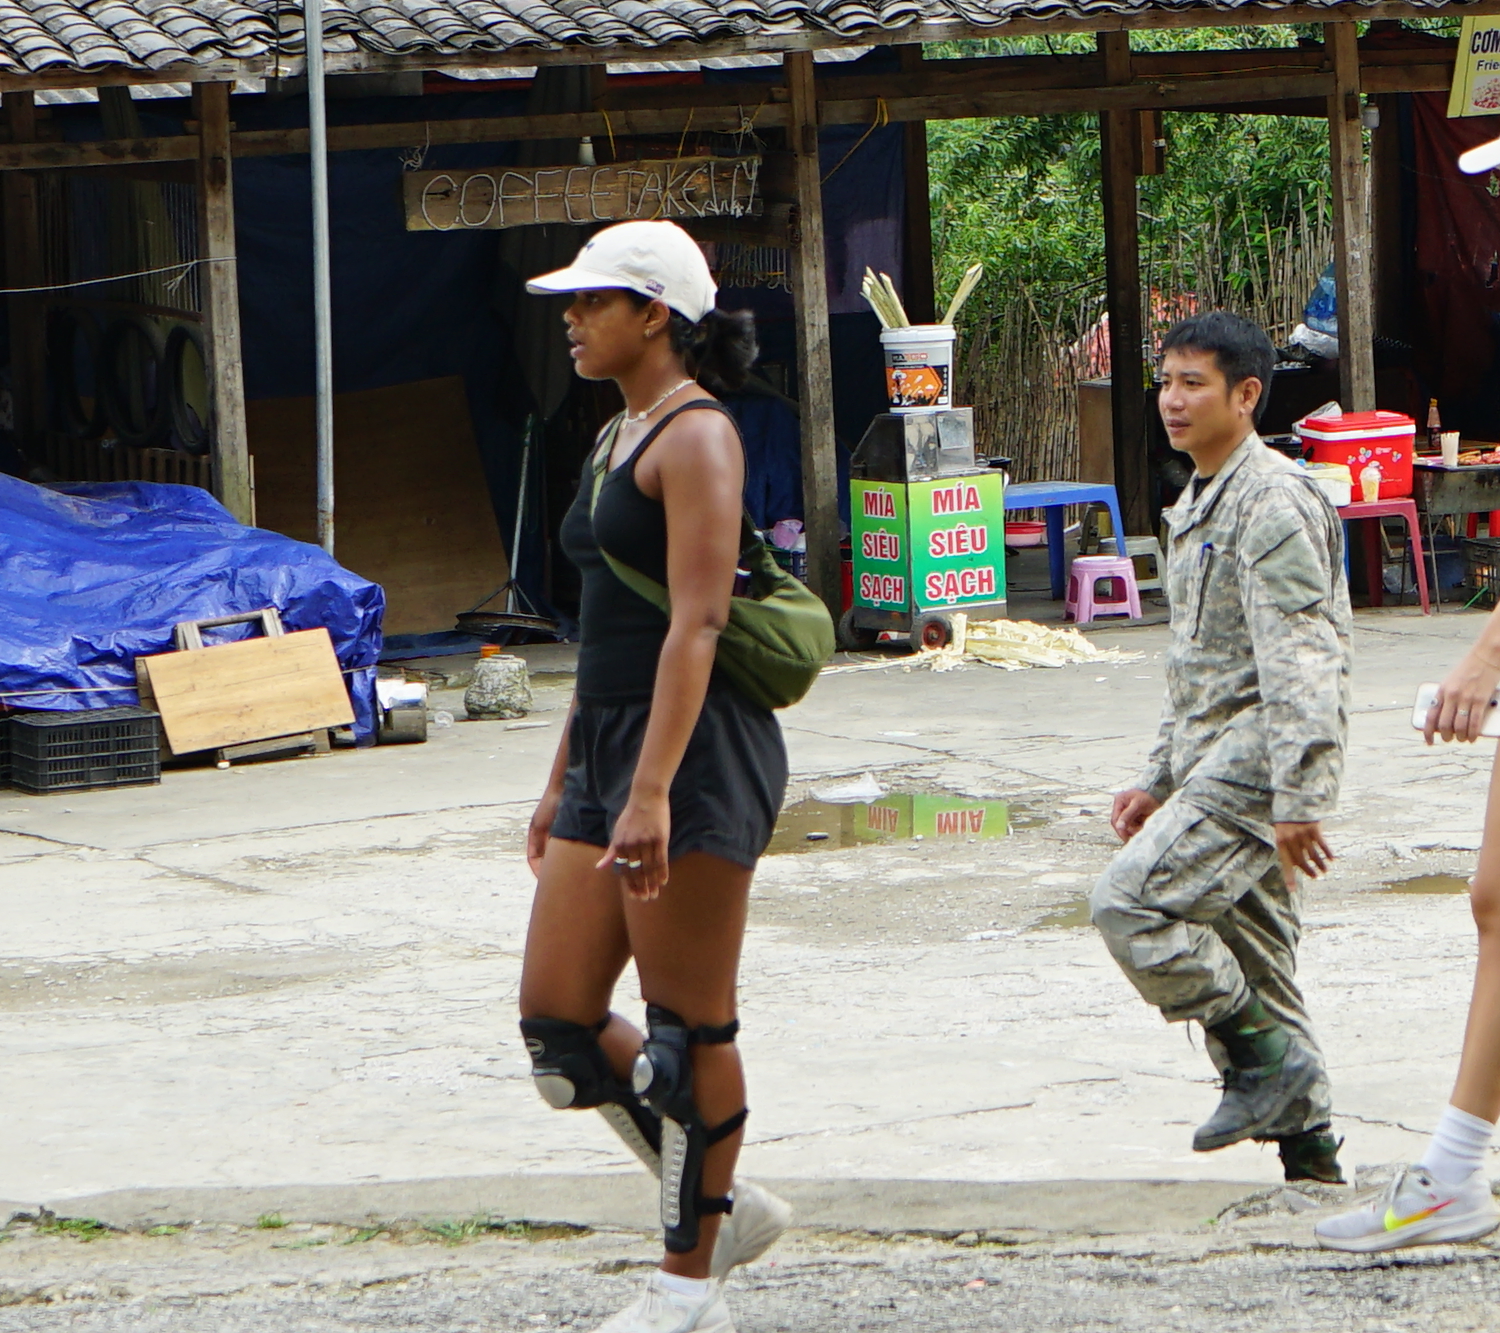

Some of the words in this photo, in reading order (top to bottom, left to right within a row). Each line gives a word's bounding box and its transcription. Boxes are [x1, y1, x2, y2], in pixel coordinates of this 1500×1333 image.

[422, 167, 614, 231] COFFEE
[863, 487, 896, 518] MÍA
[932, 482, 981, 515] MÍA
[863, 529, 899, 560] SIÊU
[930, 523, 987, 557] SIÊU
[861, 574, 904, 606] SẠCH
[926, 568, 994, 603] SẠCH
